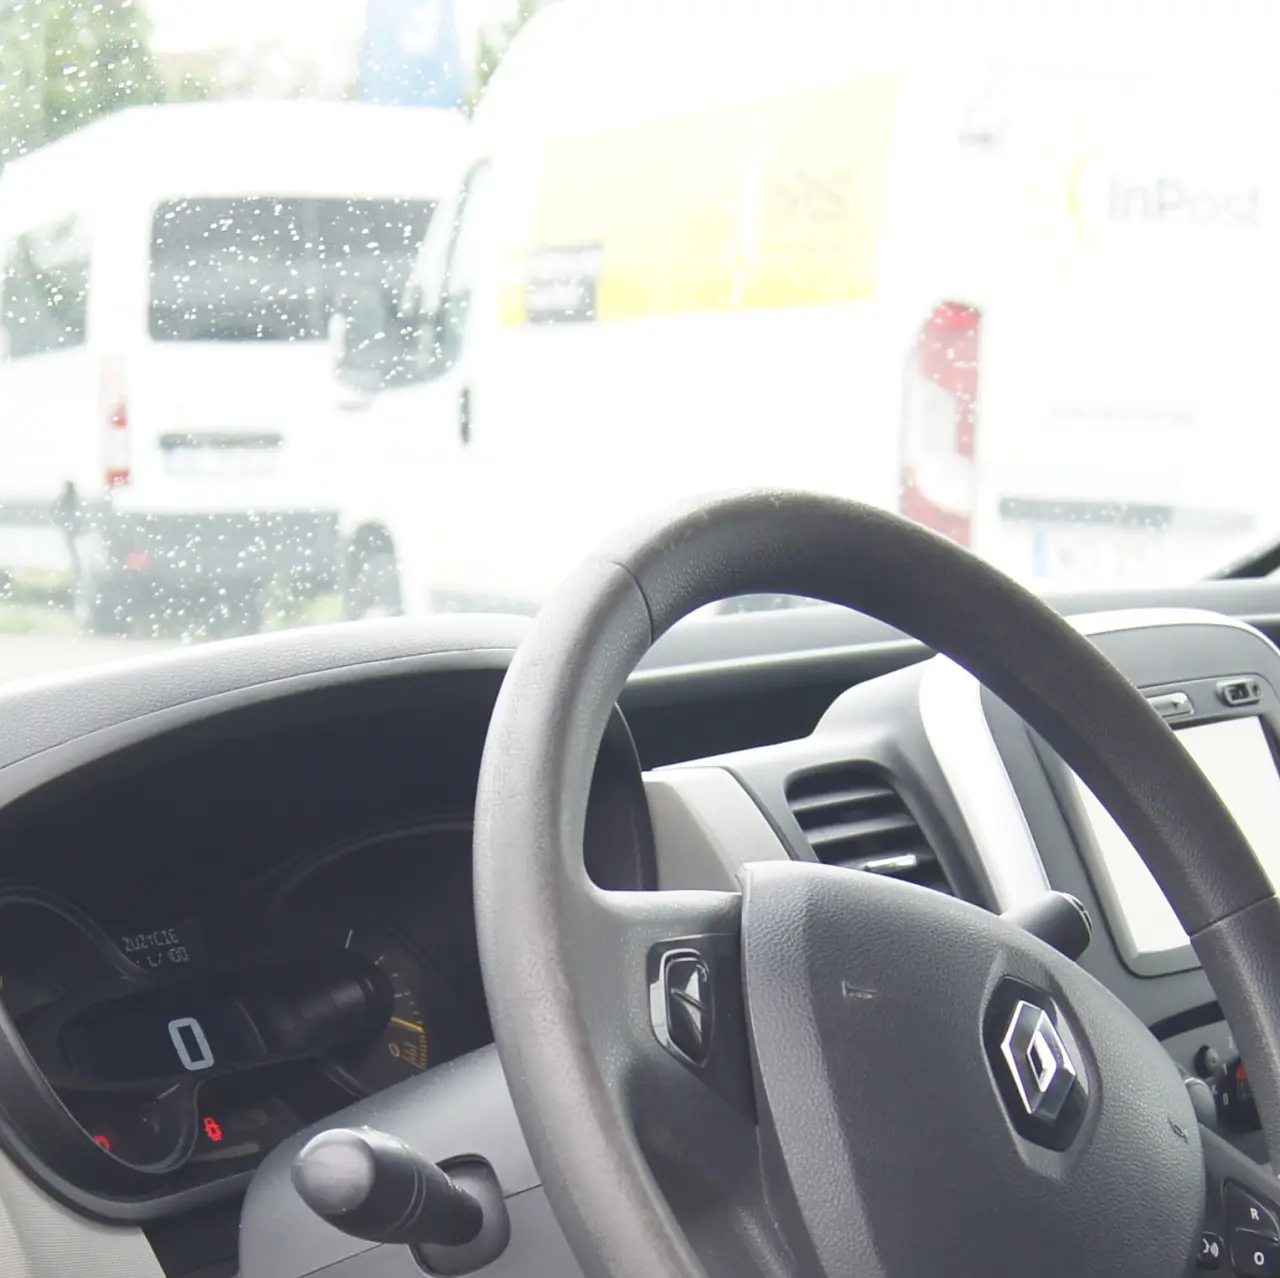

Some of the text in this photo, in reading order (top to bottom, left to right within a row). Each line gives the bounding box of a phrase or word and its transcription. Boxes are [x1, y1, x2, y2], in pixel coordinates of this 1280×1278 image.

[1107, 174, 1264, 227] InPost
[167, 1017, 214, 1071] 0
[1249, 1207, 1260, 1221] R
